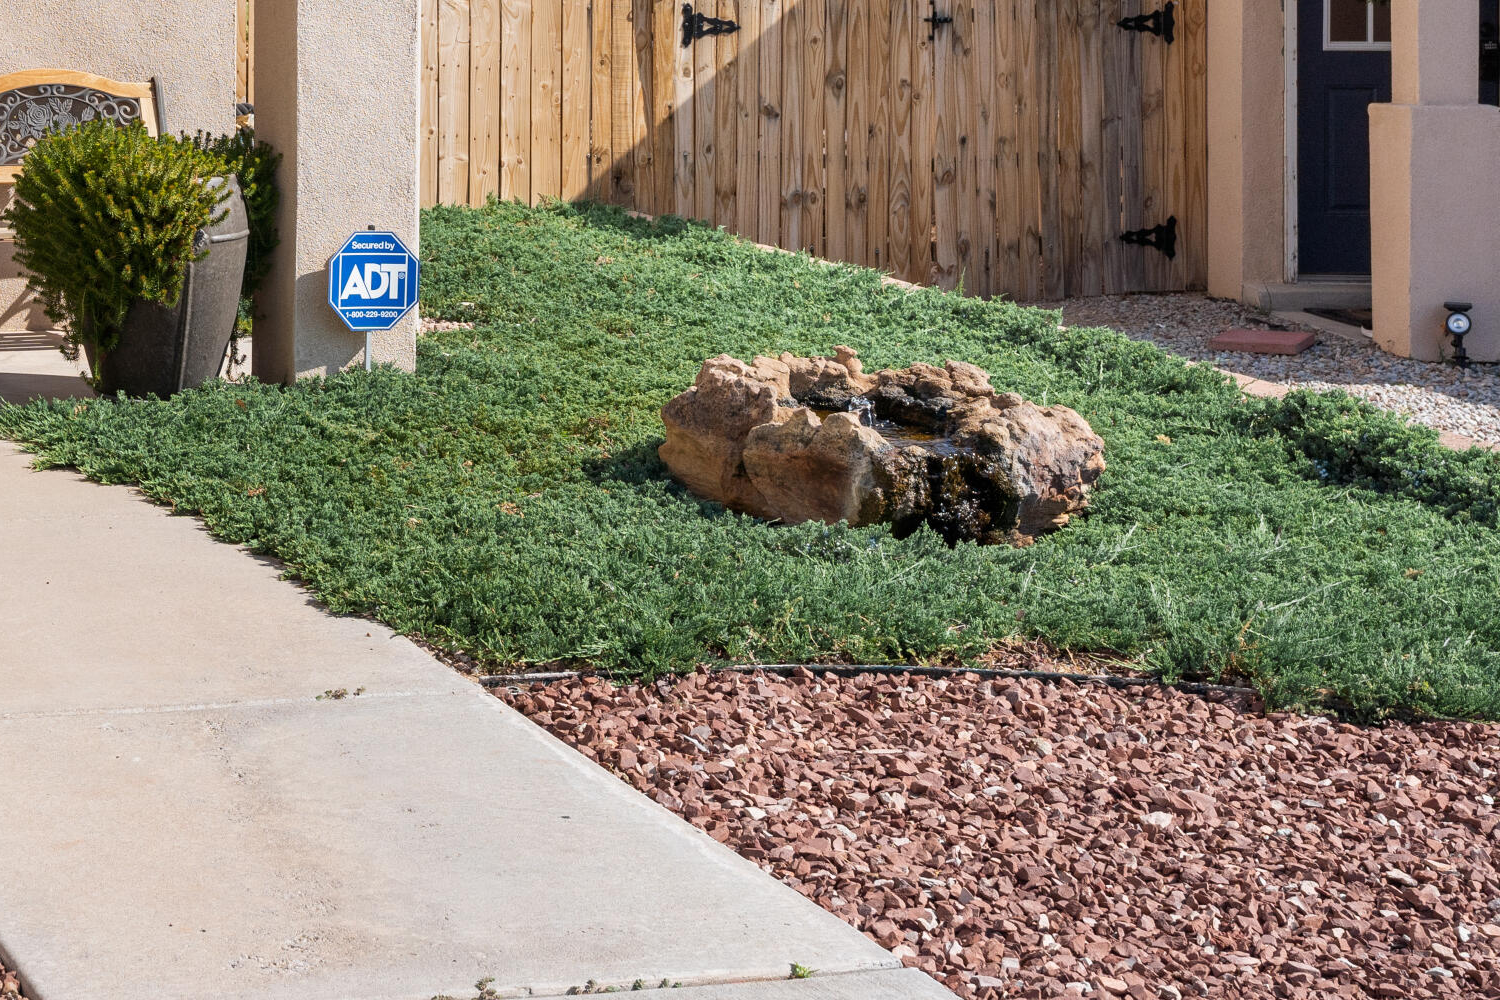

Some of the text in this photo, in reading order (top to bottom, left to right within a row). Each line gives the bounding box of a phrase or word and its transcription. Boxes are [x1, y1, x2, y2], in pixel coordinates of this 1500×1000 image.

[351, 240, 396, 251] Secured by
[340, 262, 406, 300] ADT
